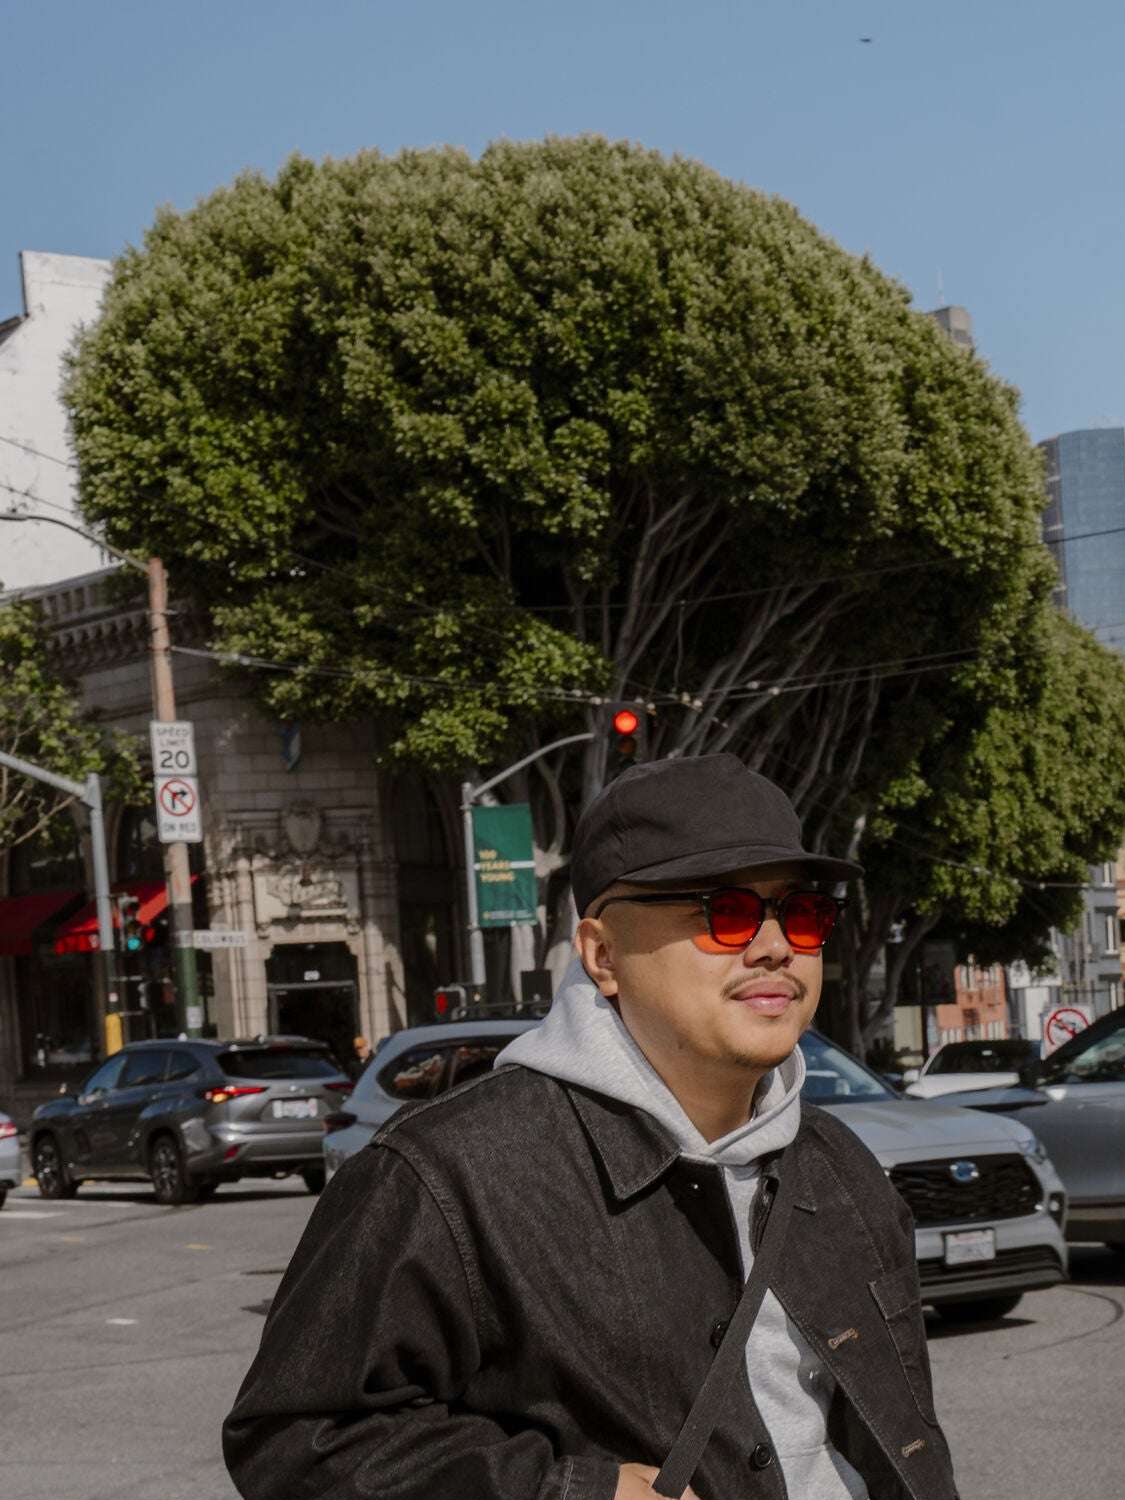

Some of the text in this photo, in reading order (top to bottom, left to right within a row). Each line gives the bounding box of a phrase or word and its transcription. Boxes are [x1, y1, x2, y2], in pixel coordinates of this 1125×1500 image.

[156, 727, 190, 737] SPEED
[160, 738, 187, 748] LIMIT
[160, 750, 190, 769] 20
[163, 822, 197, 834] ON RED
